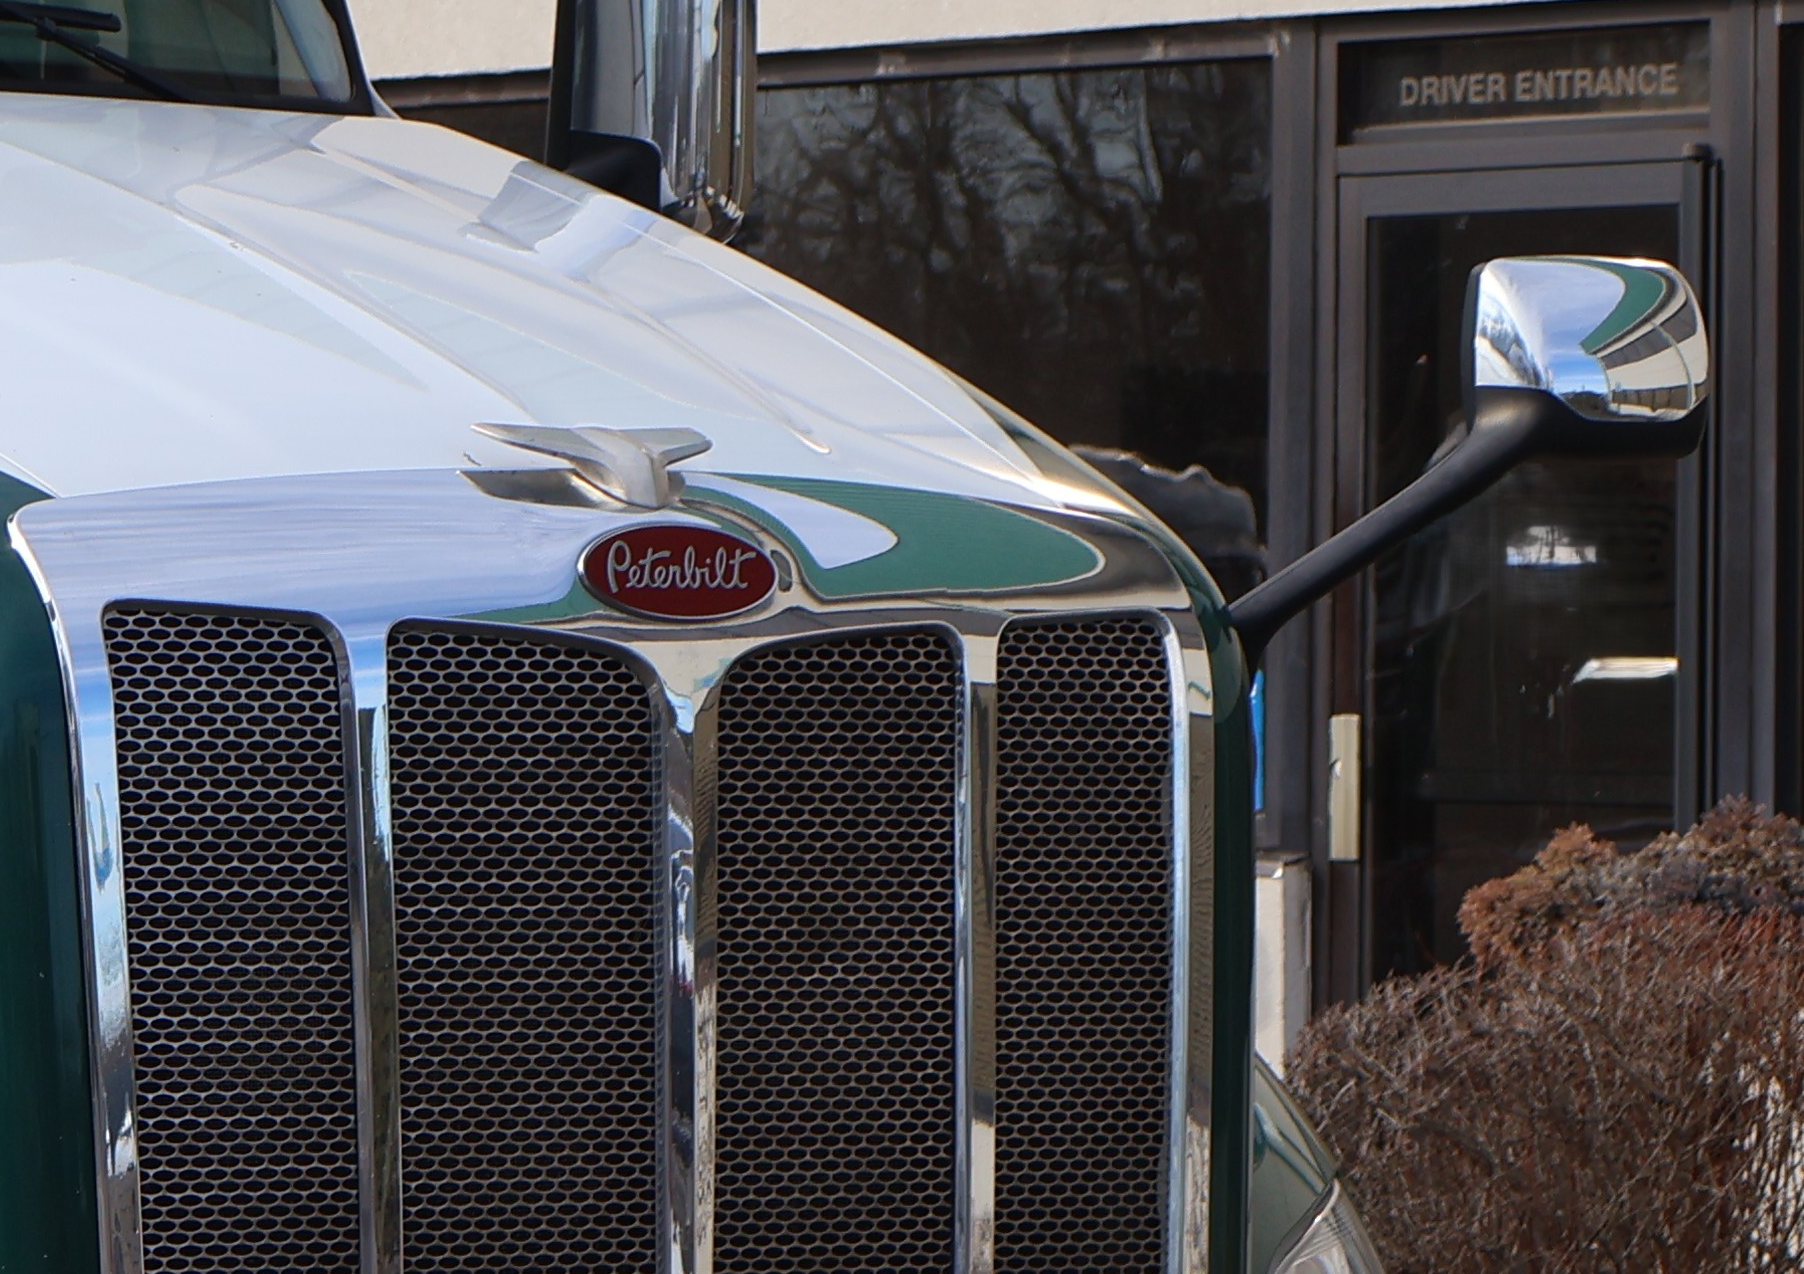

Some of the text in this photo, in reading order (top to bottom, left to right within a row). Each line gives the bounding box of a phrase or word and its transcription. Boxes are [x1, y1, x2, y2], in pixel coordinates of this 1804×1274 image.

[1399, 62, 1679, 107] DRIVER ENTRANCE
[607, 539, 757, 595] Peterbilt
